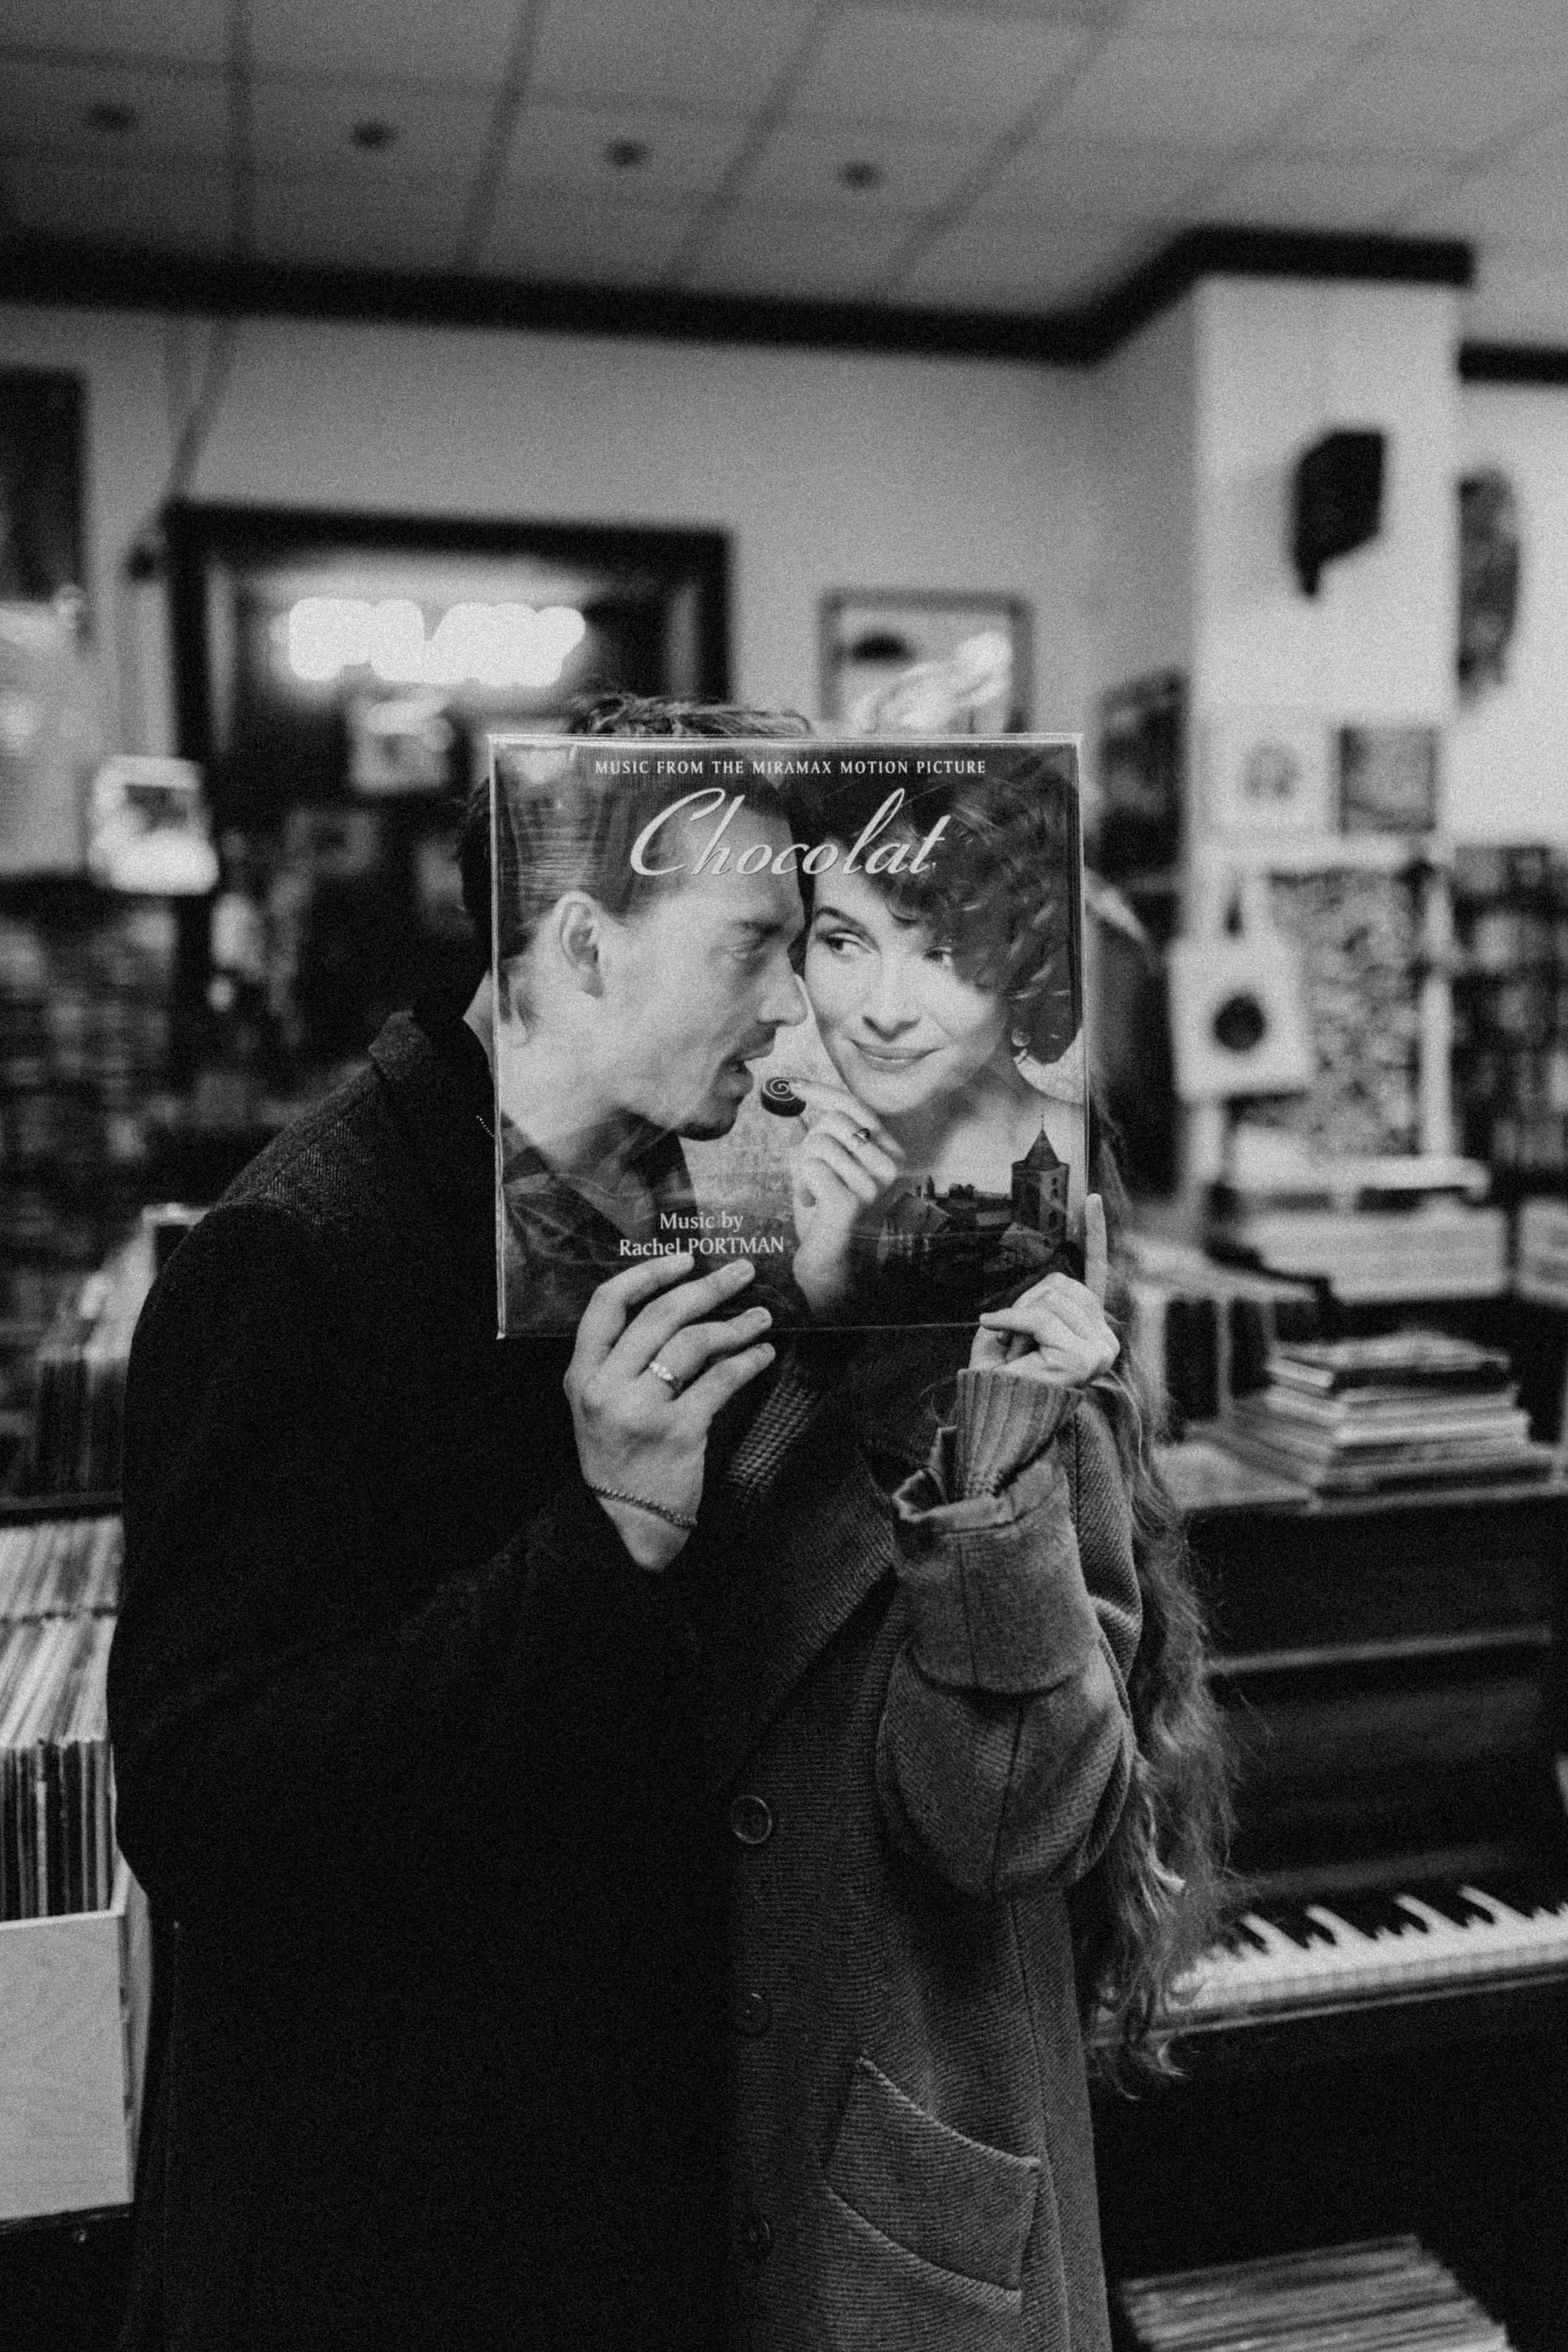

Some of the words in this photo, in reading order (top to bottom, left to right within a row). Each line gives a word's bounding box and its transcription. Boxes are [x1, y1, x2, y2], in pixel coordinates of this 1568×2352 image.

[595, 761, 649, 774] MUSIC
[657, 761, 703, 774] FROM
[712, 761, 744, 774] THE
[753, 761, 831, 774] MIRAMAX
[840, 761, 908, 774] MOTION
[916, 760, 986, 774] PICTURE
[630, 787, 952, 876] Chocolat
[660, 1212, 715, 1229] Music
[721, 1210, 744, 1232] by
[619, 1237, 681, 1256] Rachel
[688, 1236, 784, 1254] PORTMAN
